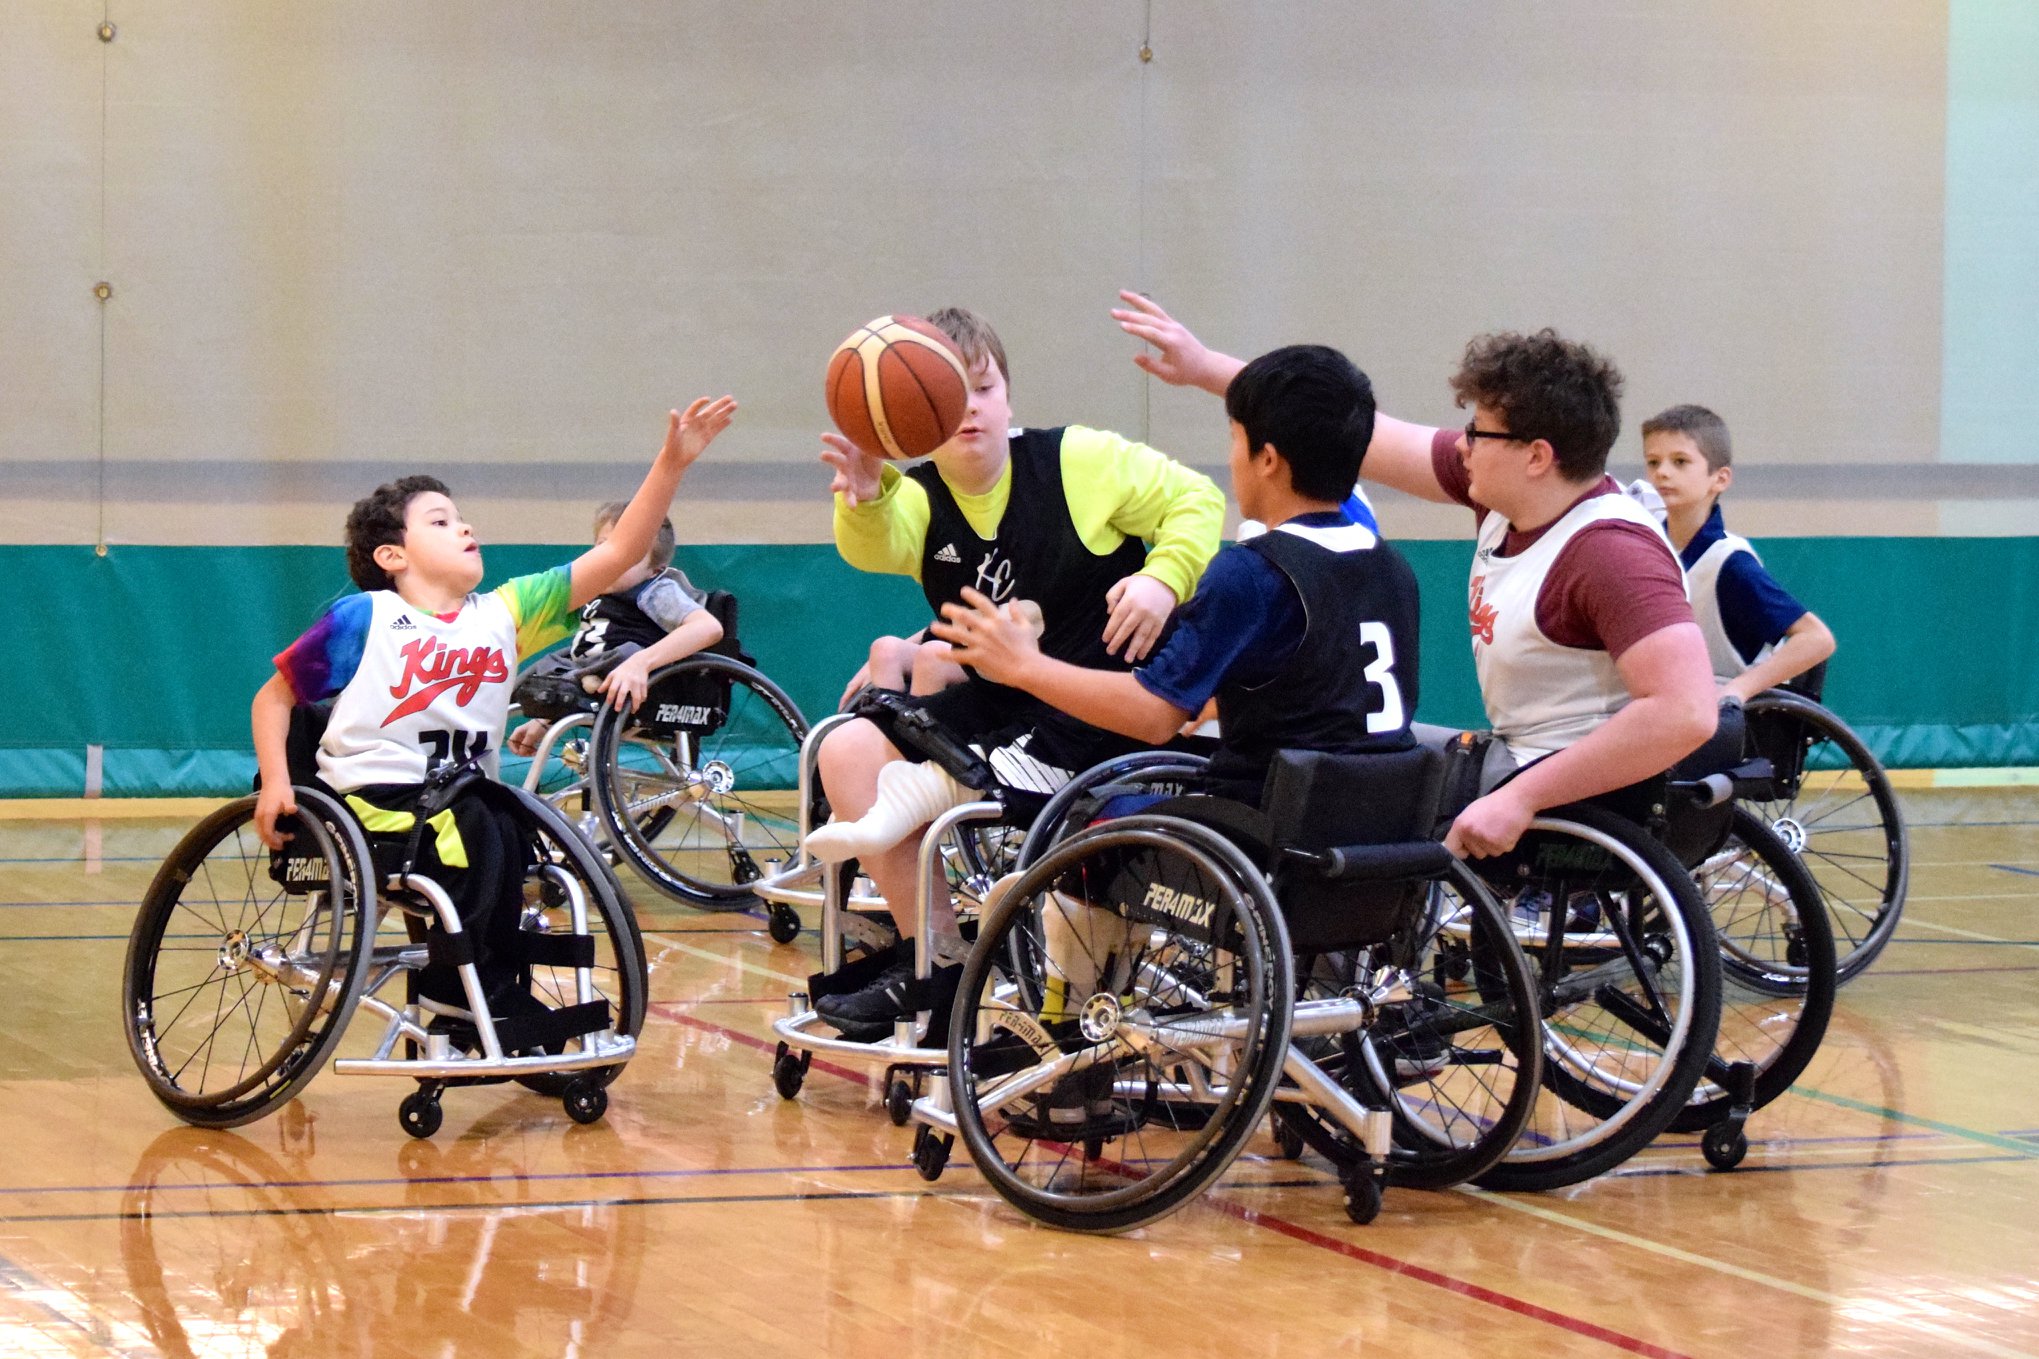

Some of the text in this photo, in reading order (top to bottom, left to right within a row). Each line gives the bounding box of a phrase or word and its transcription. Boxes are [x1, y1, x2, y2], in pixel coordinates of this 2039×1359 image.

[934, 553, 961, 564] adidas
[389, 635, 509, 708] Kings
[1359, 621, 1404, 734] 3
